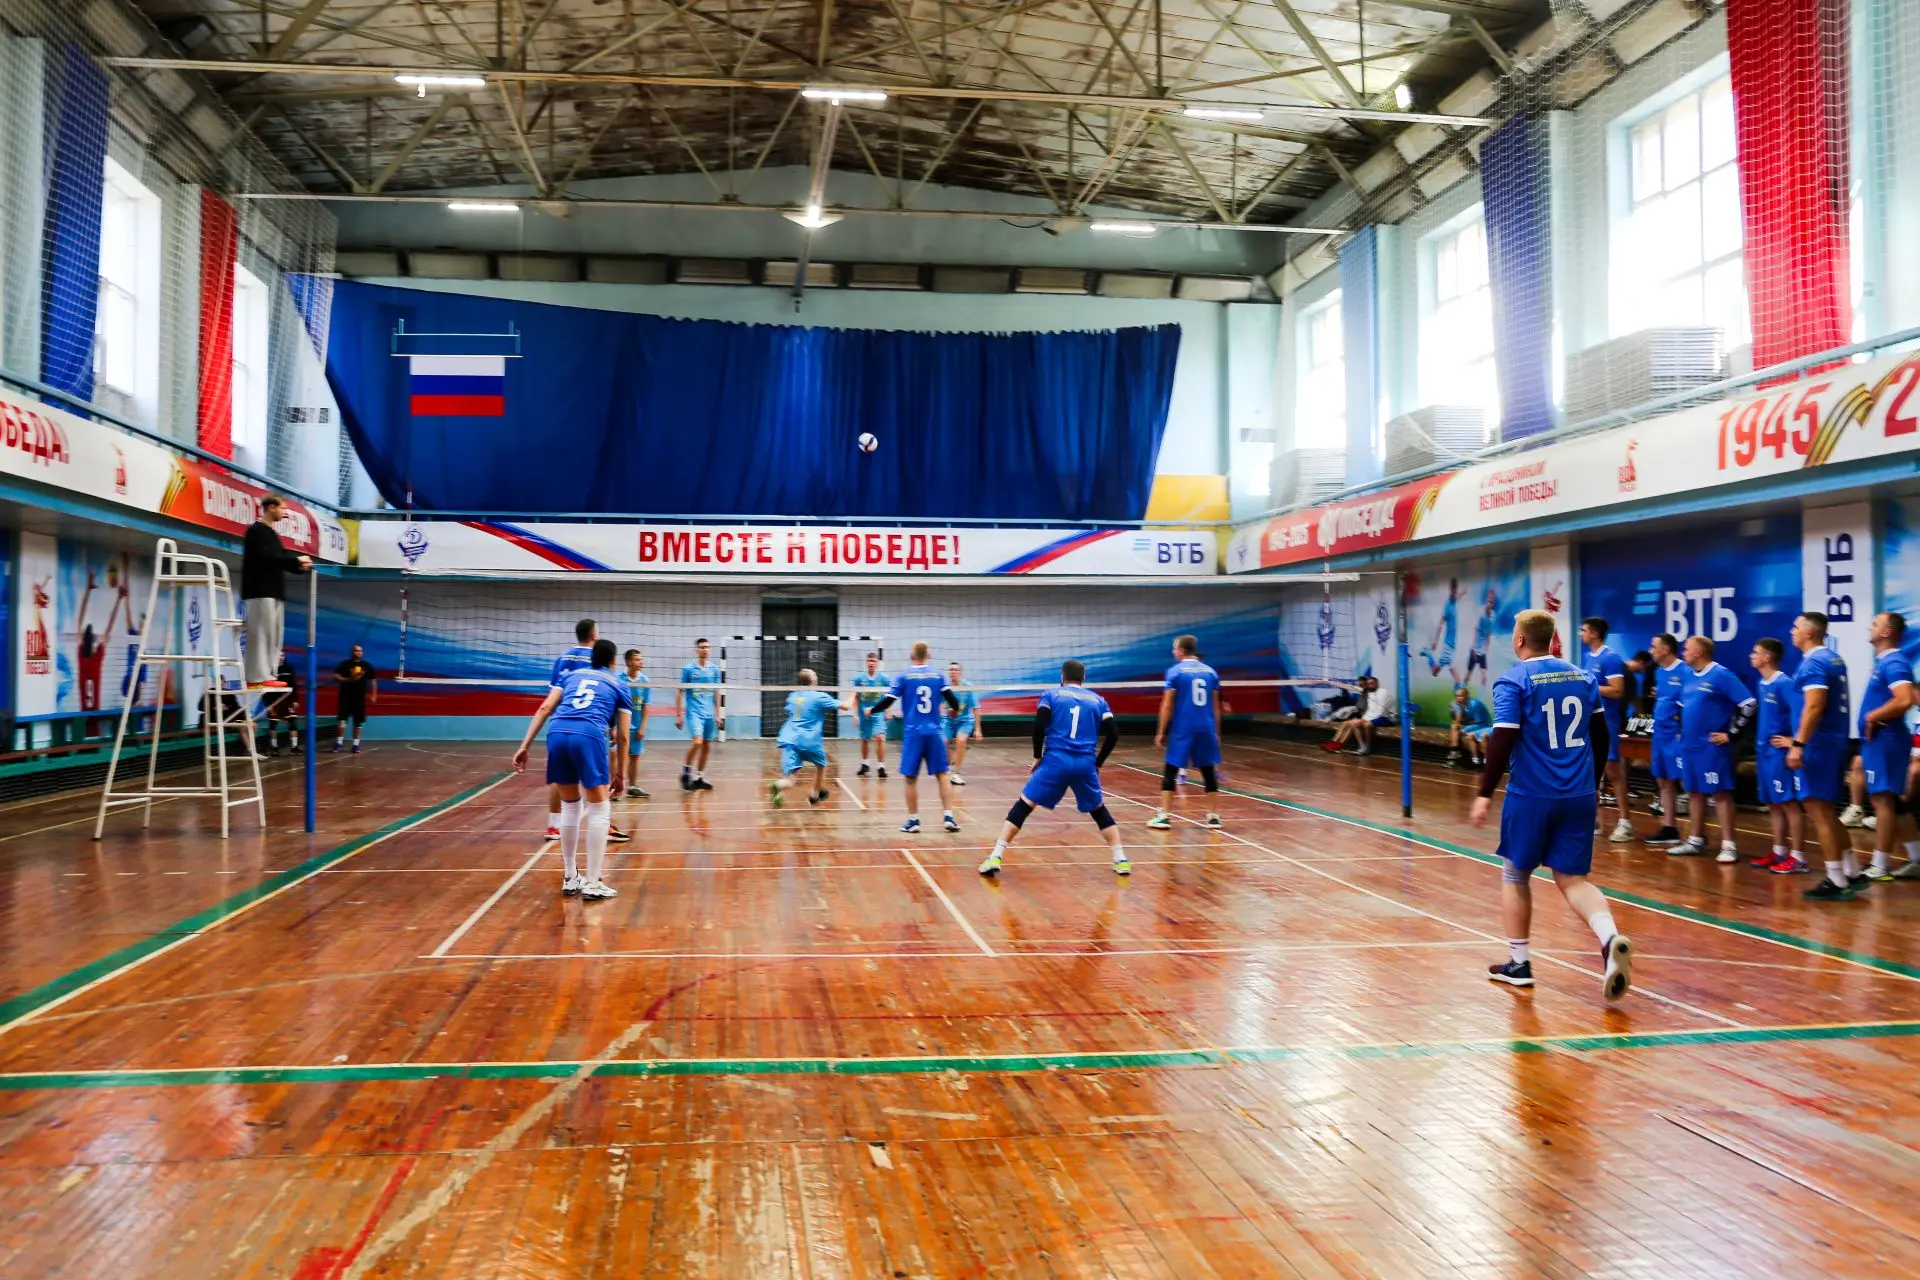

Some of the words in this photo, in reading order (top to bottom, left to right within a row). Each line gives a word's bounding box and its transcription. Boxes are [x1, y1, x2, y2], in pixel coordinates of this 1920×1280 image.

[1717, 382, 1833, 470] 1945
[639, 531, 773, 563] ВМЕСТЕ
[820, 533, 961, 570] ПОБЕДЕ!
[1157, 542, 1204, 564] ВТБ
[1825, 532, 1854, 622] ВТБ
[1664, 587, 1738, 643] ВТБ
[571, 679, 600, 710] 5
[916, 685, 933, 714] 3
[1191, 678, 1208, 707] 6
[1069, 705, 1080, 739] 1
[1541, 695, 1586, 750] 12
